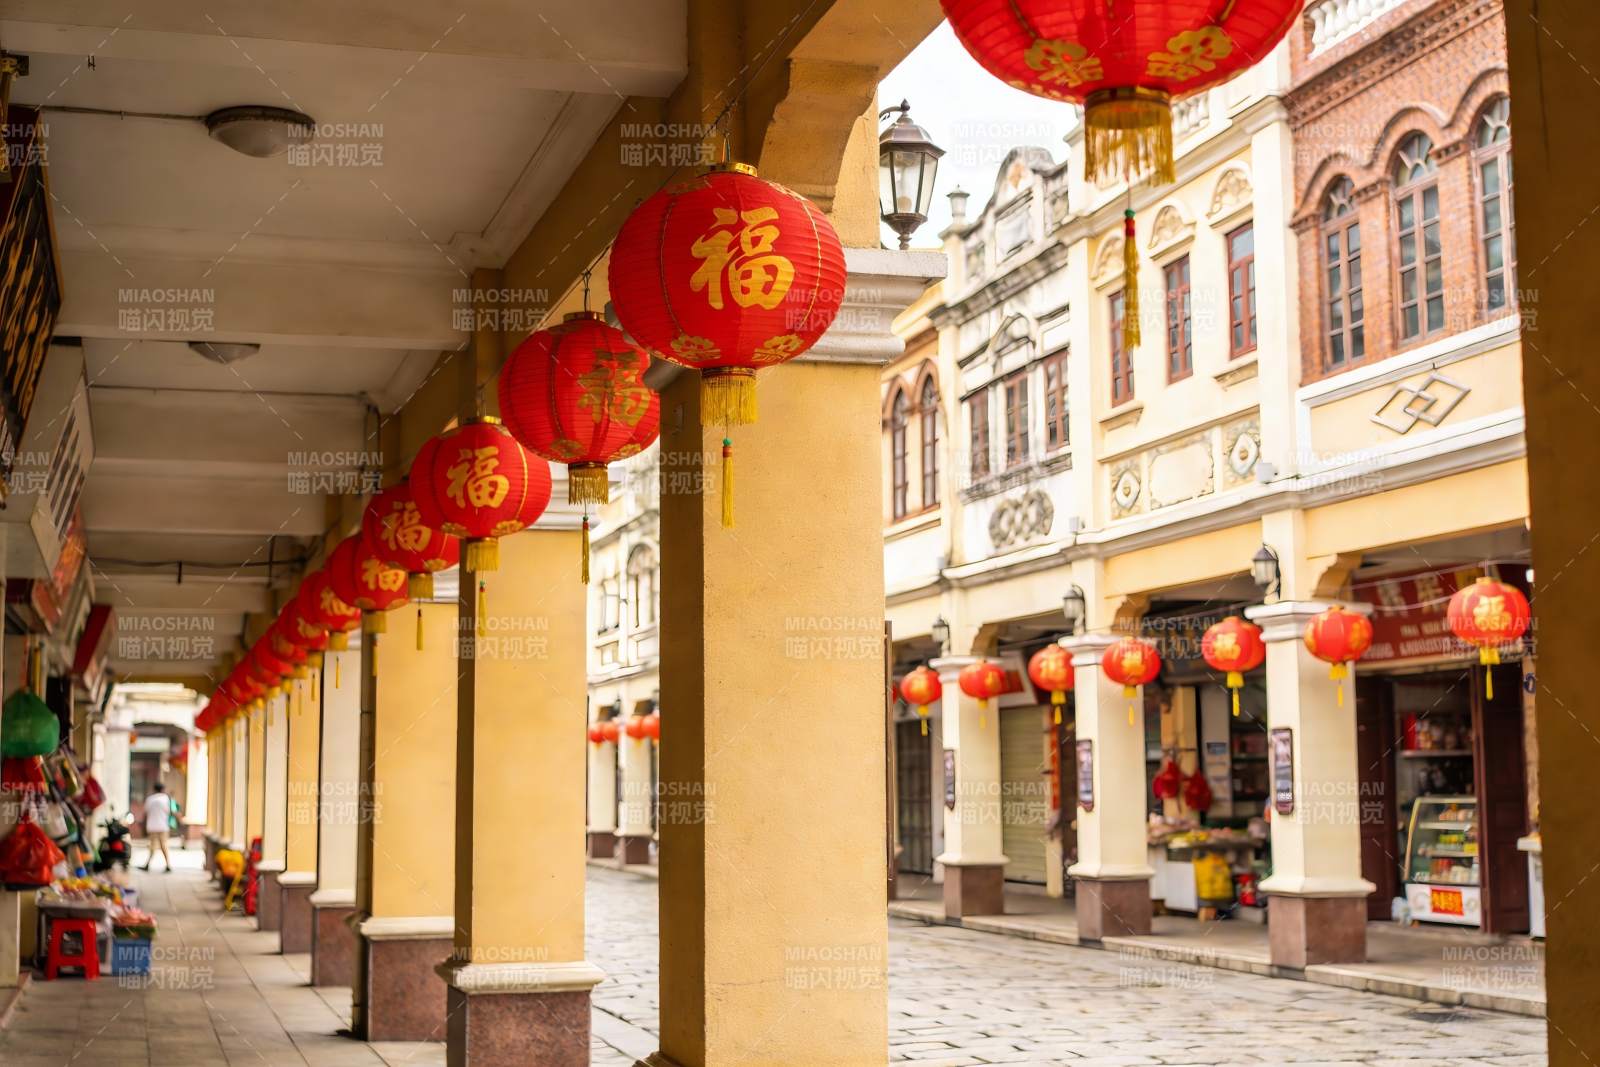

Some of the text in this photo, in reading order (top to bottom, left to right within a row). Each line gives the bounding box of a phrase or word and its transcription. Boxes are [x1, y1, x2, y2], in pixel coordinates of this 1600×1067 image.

[690, 206, 795, 310] 福
[577, 348, 651, 426] 福
[446, 446, 509, 508] 福
[381, 501, 431, 552] 福
